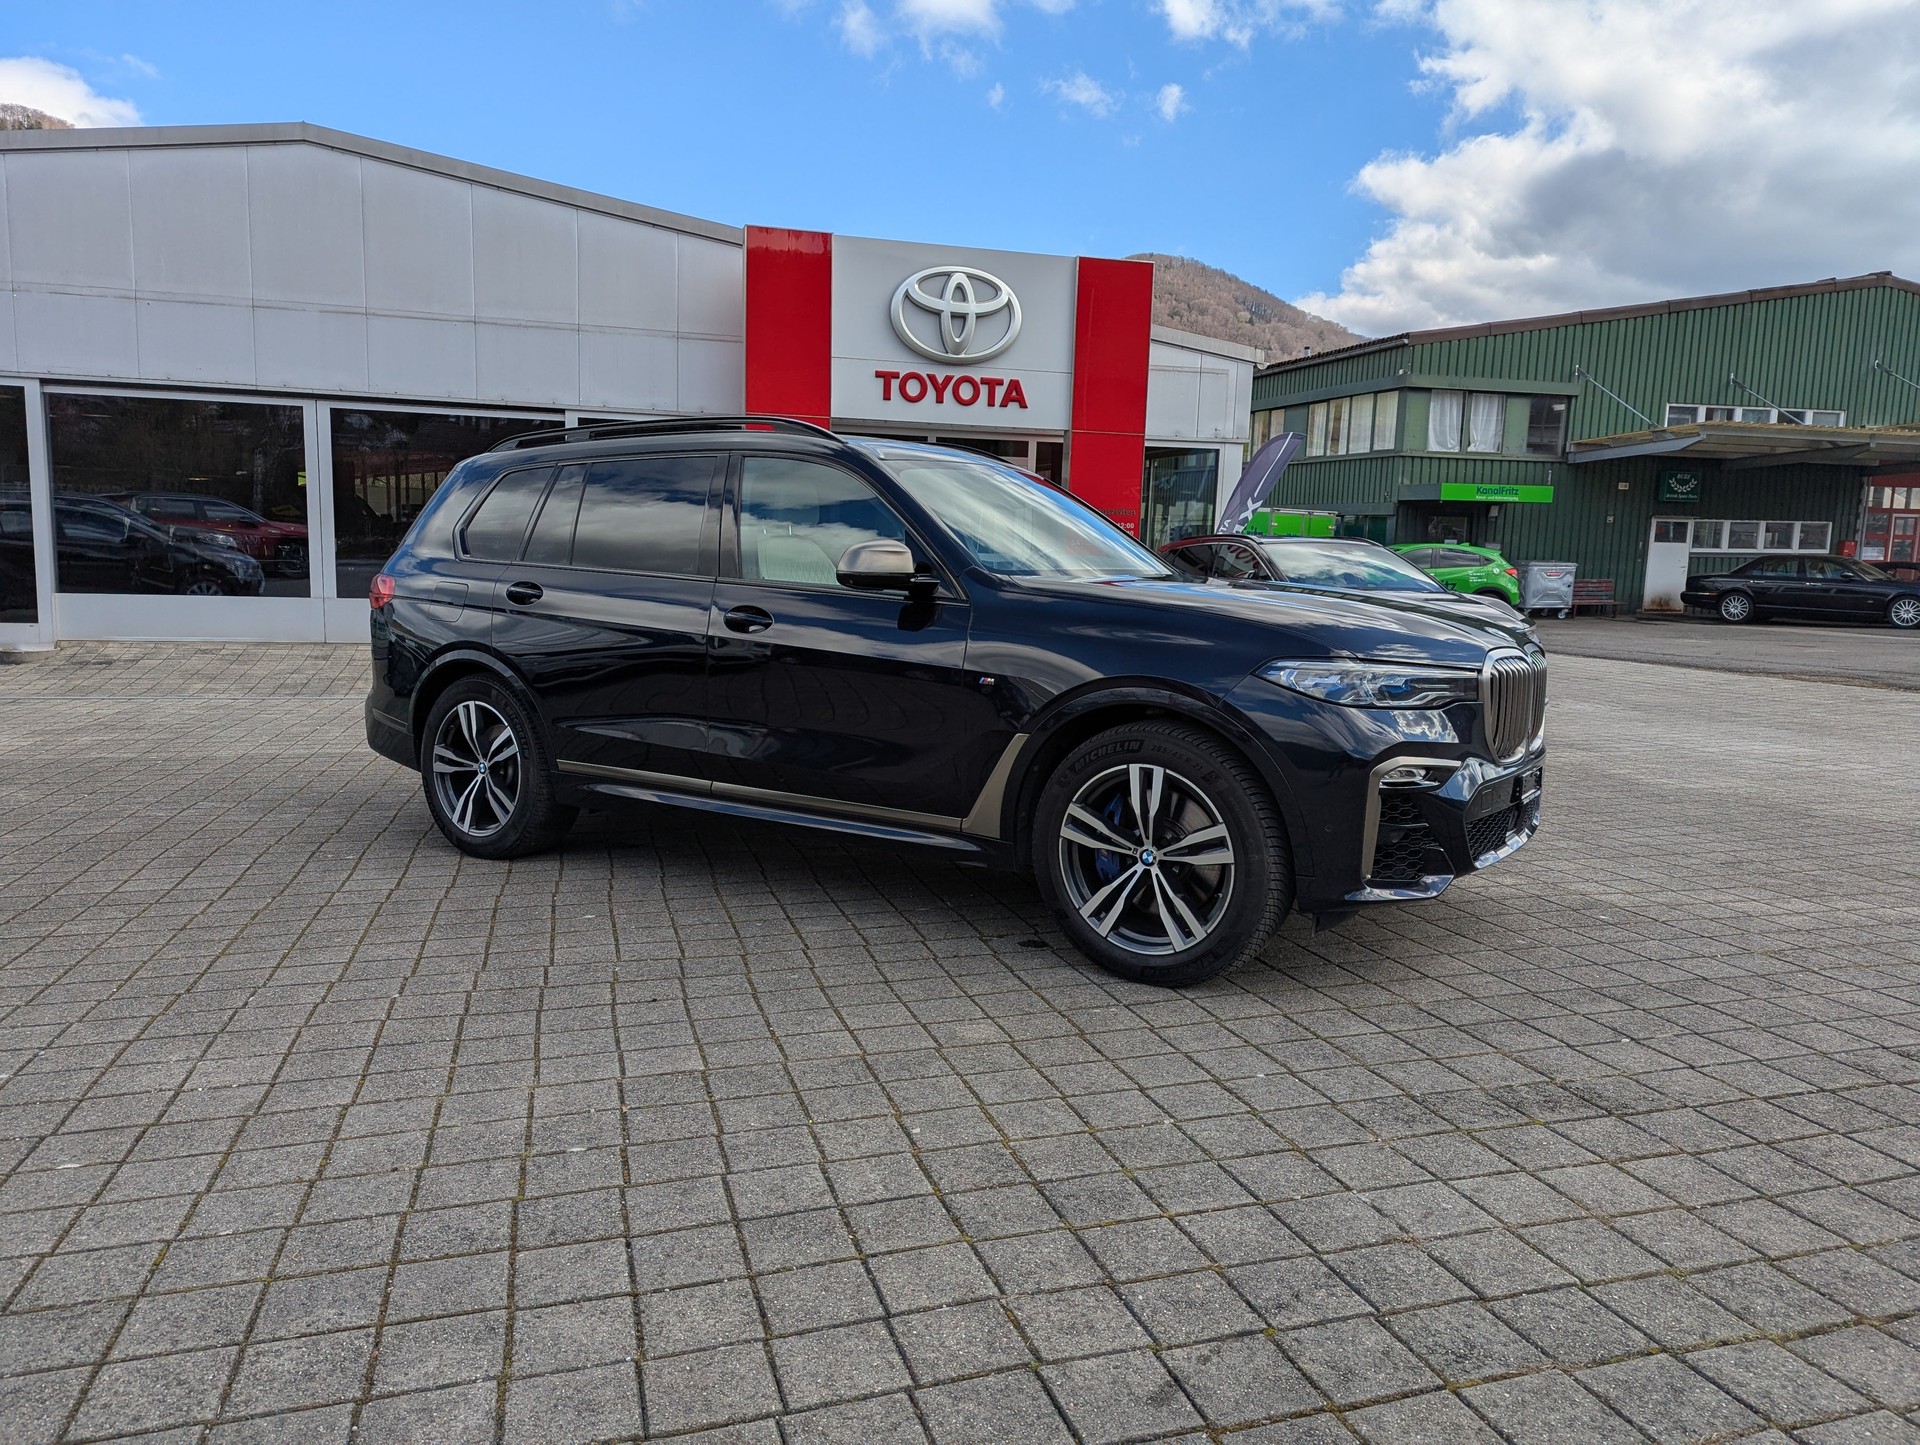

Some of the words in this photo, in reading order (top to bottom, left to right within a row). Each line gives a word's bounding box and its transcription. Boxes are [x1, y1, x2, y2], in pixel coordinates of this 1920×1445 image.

[875, 370, 1028, 409] TOYOTA
[1476, 486, 1519, 495] KanalFritz
[1074, 741, 1141, 774] MICHELIN
